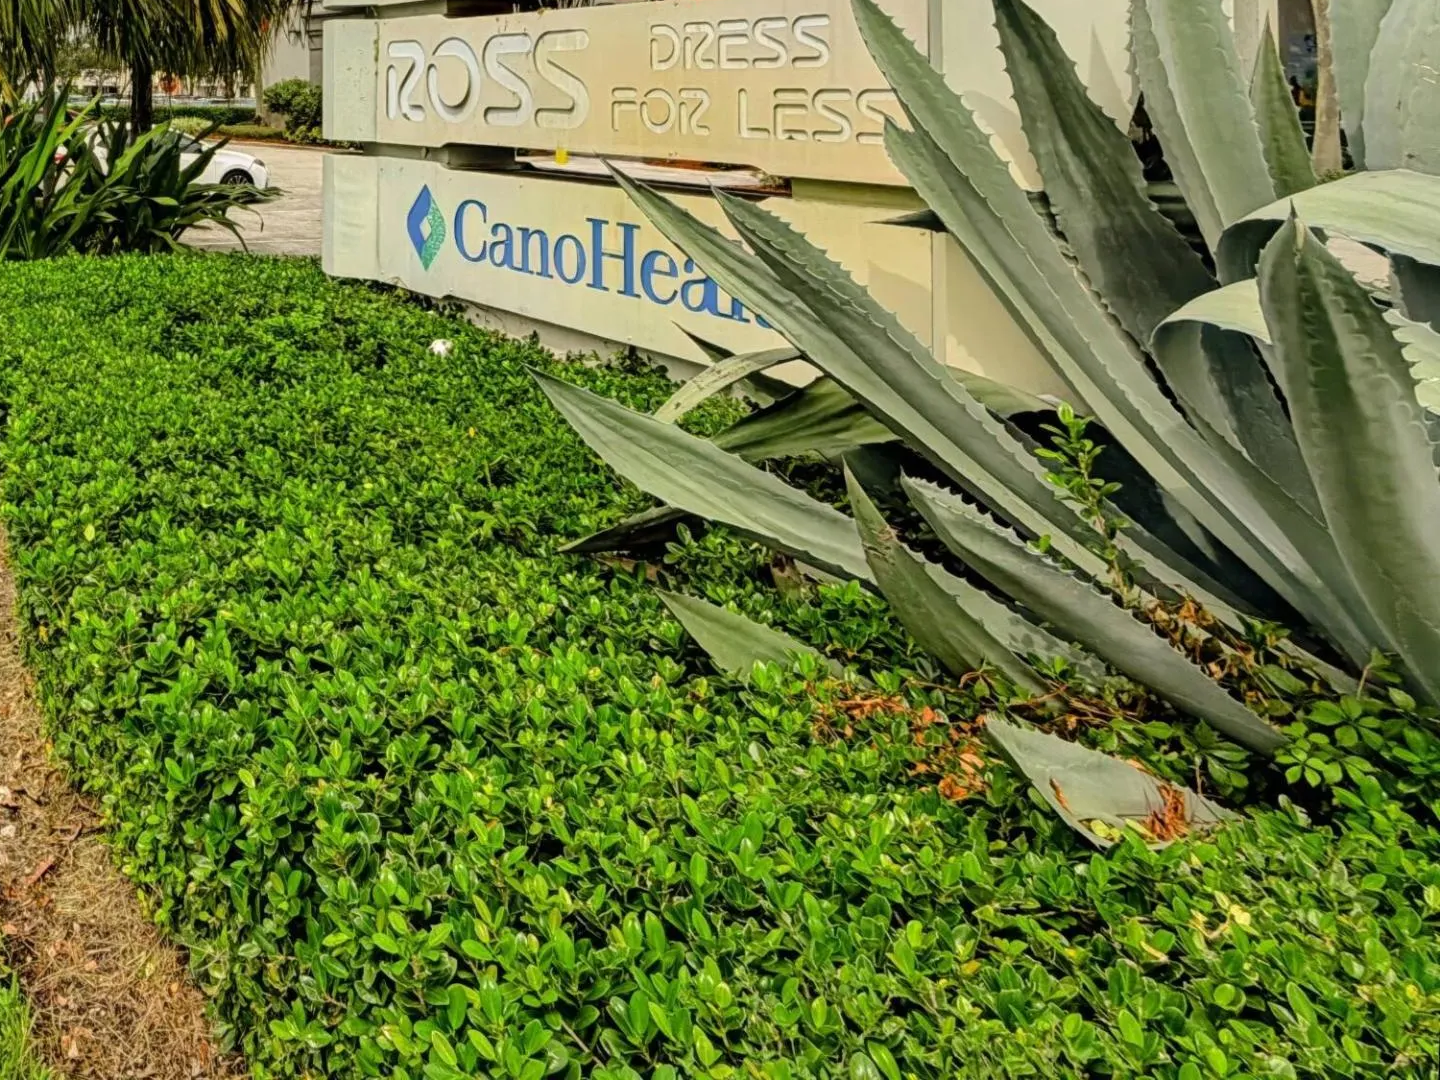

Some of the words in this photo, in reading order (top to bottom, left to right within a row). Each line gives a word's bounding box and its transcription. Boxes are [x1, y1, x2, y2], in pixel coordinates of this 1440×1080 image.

[386, 28, 589, 129] ROSS
[650, 14, 830, 71] DRESS
[610, 87, 710, 136] FOR
[737, 87, 897, 144] LESS
[454, 199, 773, 328] CanoHea
